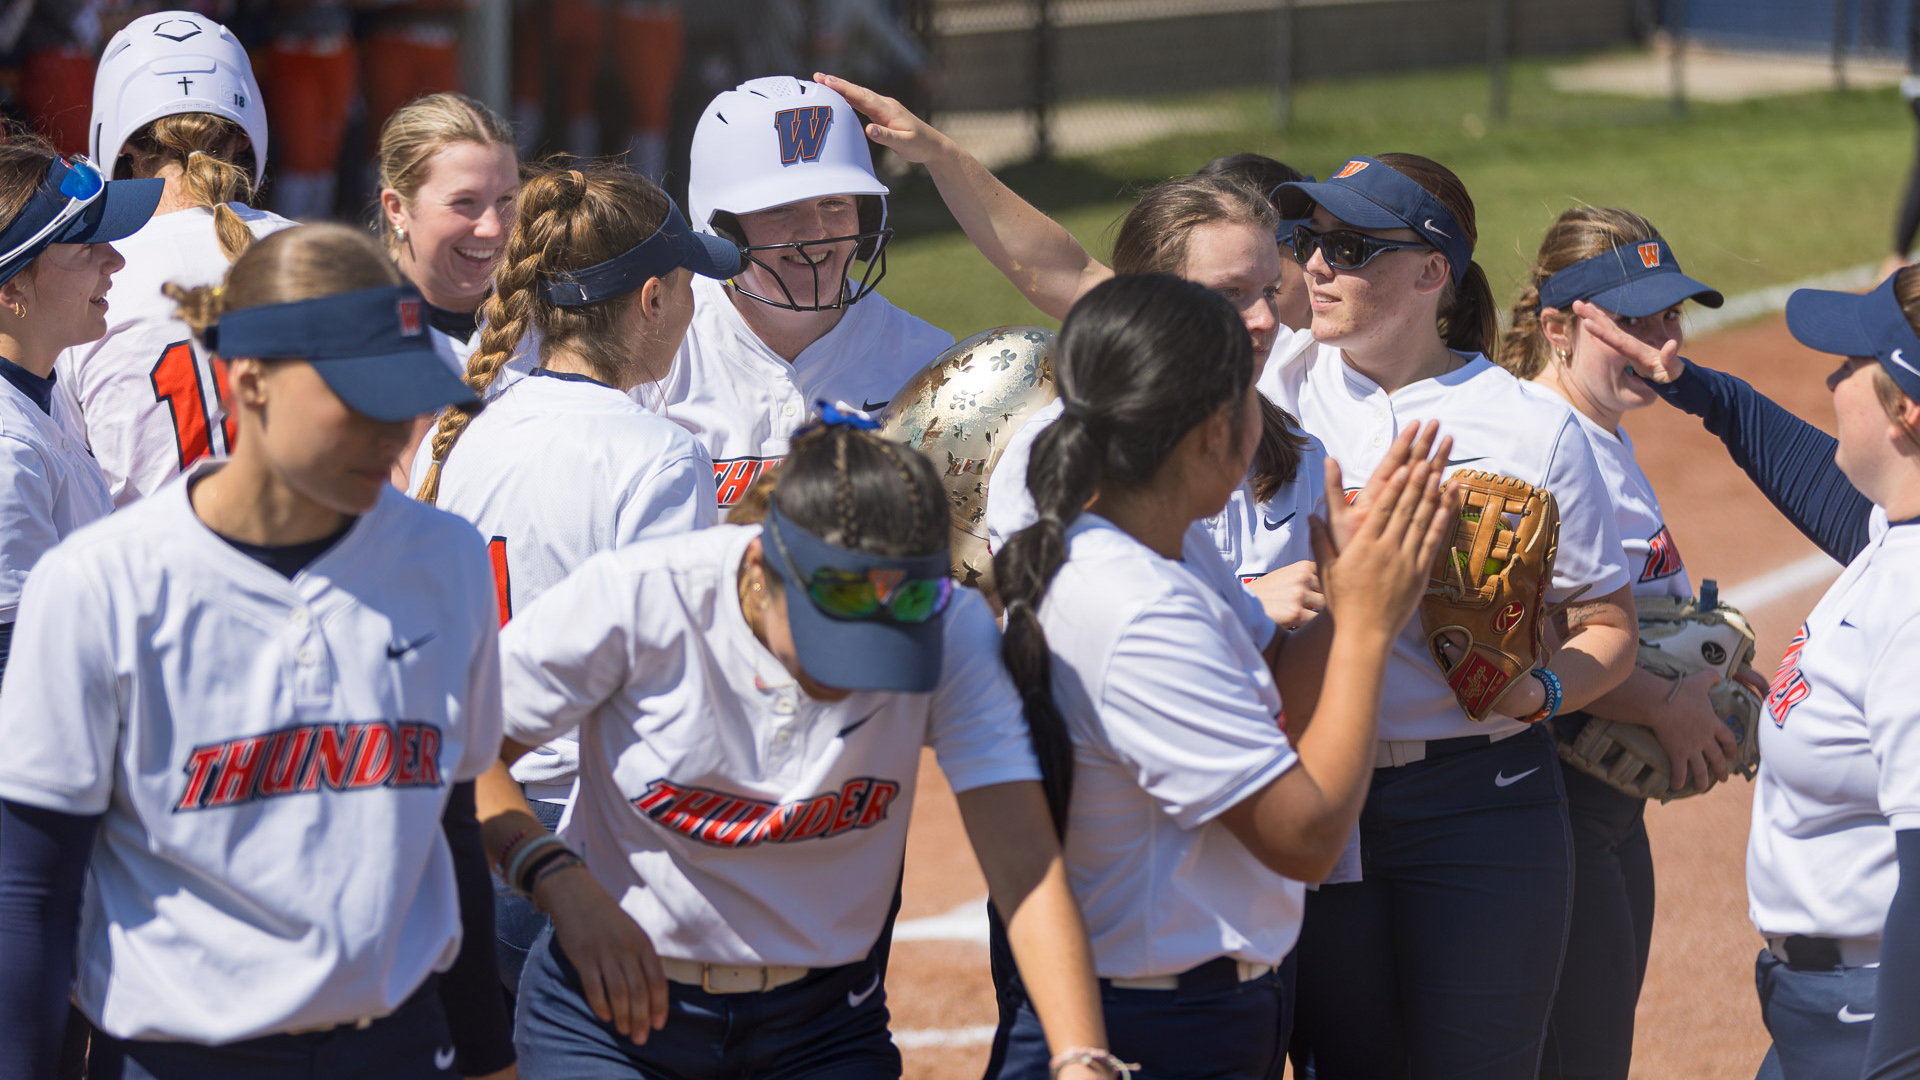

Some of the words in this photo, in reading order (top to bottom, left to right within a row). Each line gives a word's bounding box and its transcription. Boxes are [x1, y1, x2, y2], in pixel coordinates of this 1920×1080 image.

[233, 93, 245, 108] 18
[774, 105, 834, 167] W
[1332, 160, 1370, 179] W
[1637, 241, 1660, 269] W
[149, 338, 239, 475] 1
[172, 719, 444, 815] THUNDER
[629, 776, 900, 848] THUNDER
